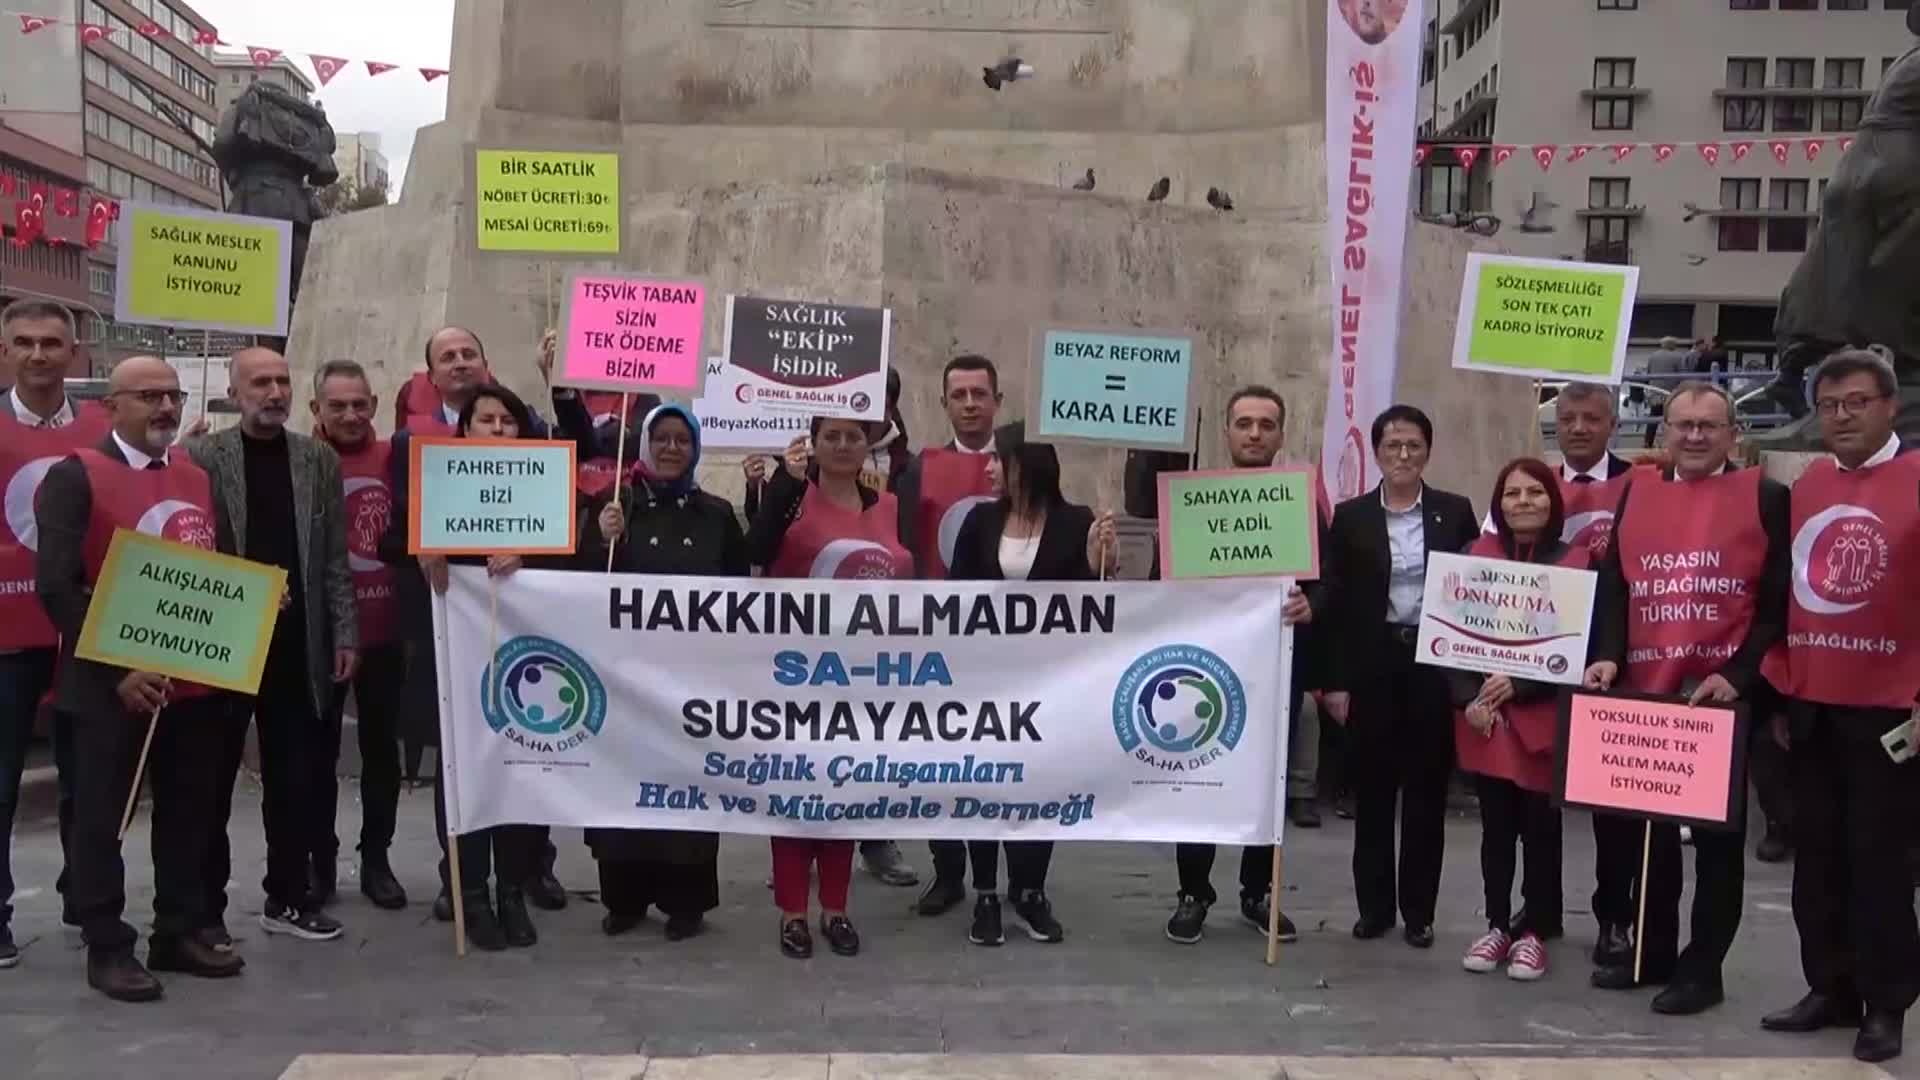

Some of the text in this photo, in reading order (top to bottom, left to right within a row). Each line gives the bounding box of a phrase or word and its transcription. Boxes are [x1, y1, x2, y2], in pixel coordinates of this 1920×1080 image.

[500, 157, 596, 177] BİR SAATLİK
[483, 189, 528, 203] NÖBET
[484, 217, 529, 231] MESAİ
[151, 226, 262, 251] SAĞLIK MESLEK
[173, 254, 238, 272] KANUNU
[166, 274, 242, 296] İSTİYORUZ
[583, 281, 697, 304] TEŞVİK TABAN
[1496, 276, 1604, 296] SÖZLEŞMELİLİĞE
[615, 308, 657, 327] SİZİN
[766, 304, 847, 327] SAĞLIK
[1502, 299, 1591, 318] SON TEK ÇATI
[1483, 319, 1604, 341] KADRO İSTİYORUZ
[584, 330, 685, 354] TEK ÖDEME
[1055, 342, 1180, 363] BEYAZ REFORM
[605, 357, 656, 379] BİZİM
[773, 353, 843, 379] İŞİDİR.
[1105, 375, 1126, 390] =
[757, 388, 793, 399] GENEL
[795, 391, 834, 402] SAĞLIK
[837, 394, 848, 404] İŞ
[1052, 400, 1177, 426] KARA LEKE
[447, 457, 545, 475] FAHRETTİN
[480, 485, 512, 504] BİZİ
[1183, 483, 1294, 507] SAHAYA ACİL
[446, 514, 545, 533] KAHRETTİN
[1208, 512, 1272, 533] VE ADİL
[1209, 545, 1273, 562] ATAMA
[1640, 551, 1720, 573] YAŞASIN
[139, 562, 245, 602] ALKIŞLARLA
[1472, 569, 1541, 588] MESLEK
[1631, 574, 1745, 598] AM BAĞIMSIZ
[156, 598, 214, 626] KARIN
[610, 588, 1116, 635] HAKKINI ALMADAN
[1454, 587, 1556, 614] ONURUMA
[1640, 599, 1718, 624] TÜRKİYE
[1464, 615, 1539, 636] DOKUNMA
[119, 624, 232, 663] DOYMUYOR
[1452, 643, 1487, 656] GENEL
[1490, 649, 1530, 662] SAĞLIK
[1533, 654, 1544, 666] İŞ
[1163, 651, 1184, 662] HAK
[1187, 652, 1199, 660] VE
[773, 651, 953, 686] SA-HA
[682, 700, 1043, 741] SUSMAYACAK
[1590, 708, 1714, 734] YOKSULLUK SINIRI
[505, 727, 589, 752] SA-HA DER
[1601, 729, 1698, 753] ÜZERİNDE TEK
[704, 752, 1024, 788] Sağlık Çalışanları
[1136, 747, 1223, 772] SA-HA DER
[1601, 754, 1695, 778] KALEM MAAŞ
[1610, 774, 1682, 796] İSTİYORUZ
[635, 782, 1096, 826] Hak ve Mücadele Derneği
